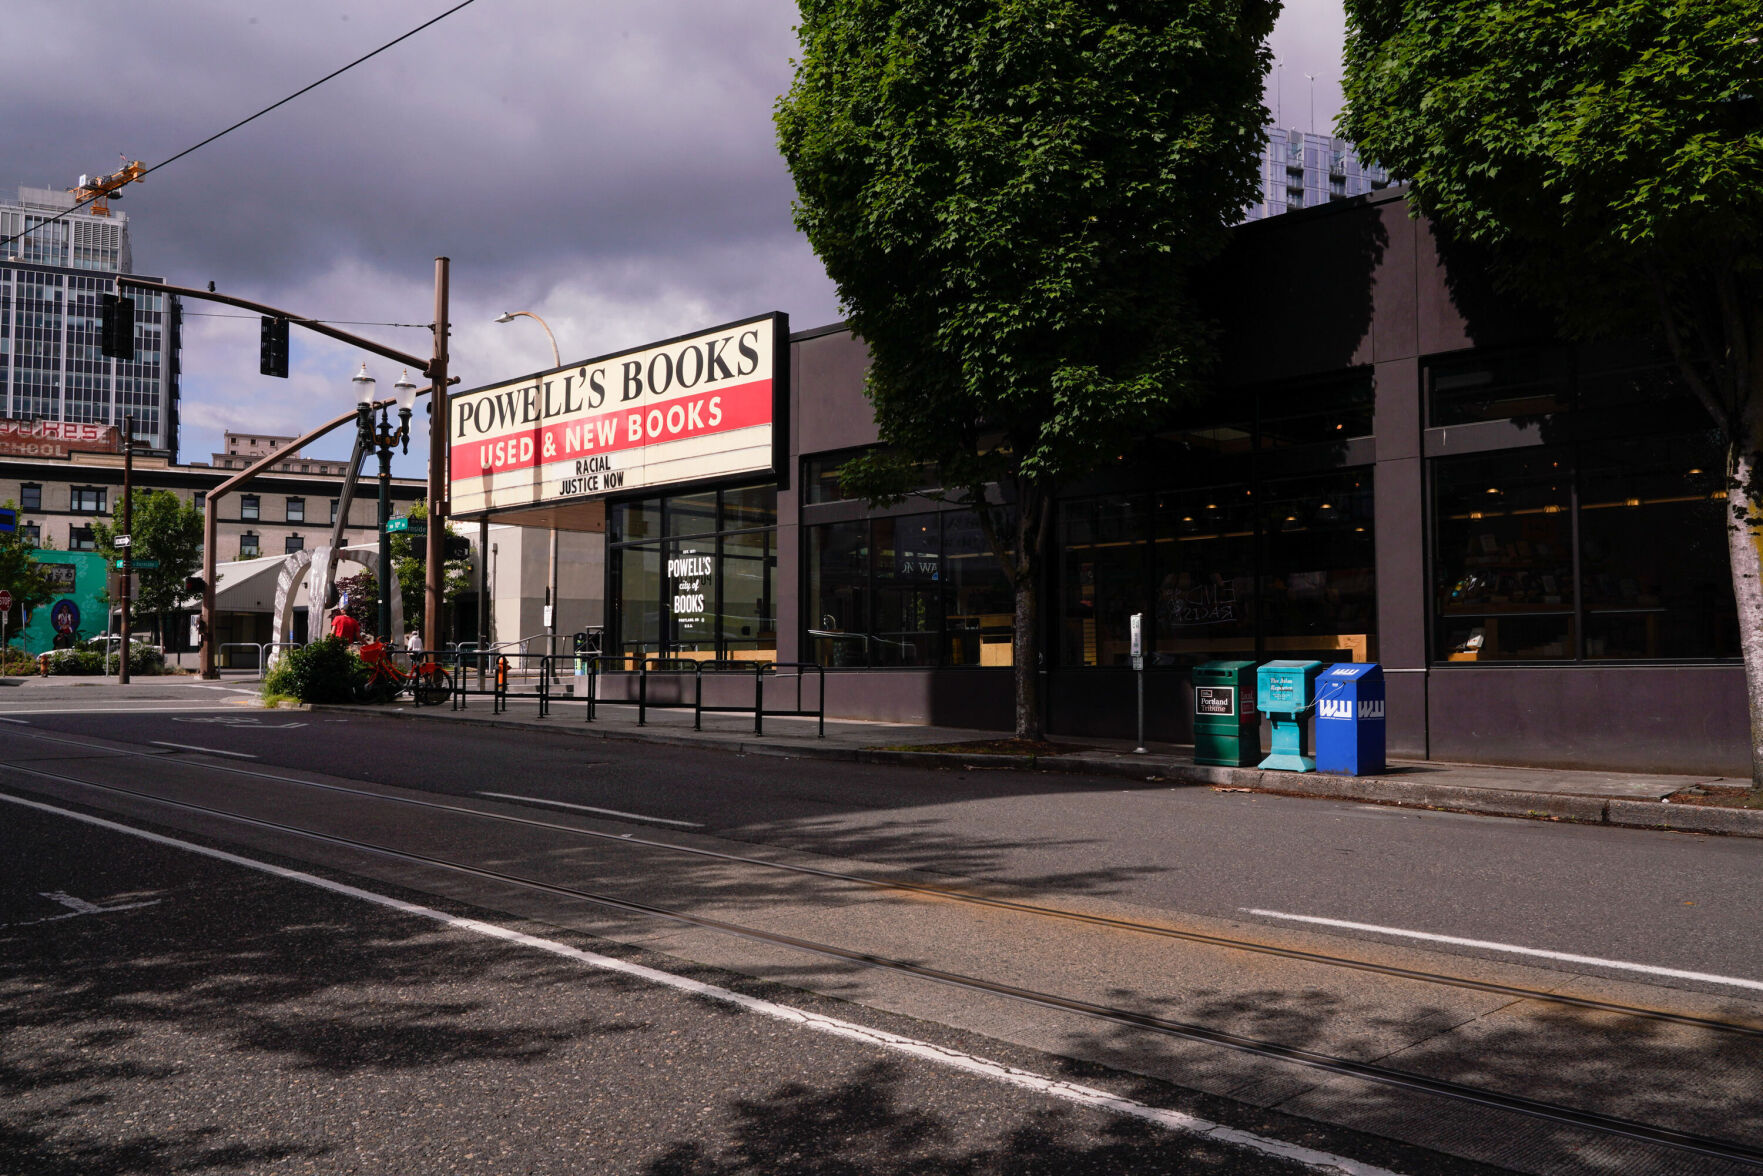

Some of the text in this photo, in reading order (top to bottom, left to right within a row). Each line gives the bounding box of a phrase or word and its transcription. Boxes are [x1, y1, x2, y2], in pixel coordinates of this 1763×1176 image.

[457, 328, 760, 438] POWELL'S BOOKS
[480, 396, 723, 470] USED & NEW BOOKS
[575, 455, 611, 475] RACIAL
[559, 471, 624, 496] JUSTICE NOW
[667, 556, 711, 578] POWELL'S
[679, 579, 700, 592] city of
[674, 594, 704, 614] BOOKS
[1200, 697, 1228, 705] Portland
[1201, 704, 1226, 712] Tribune
